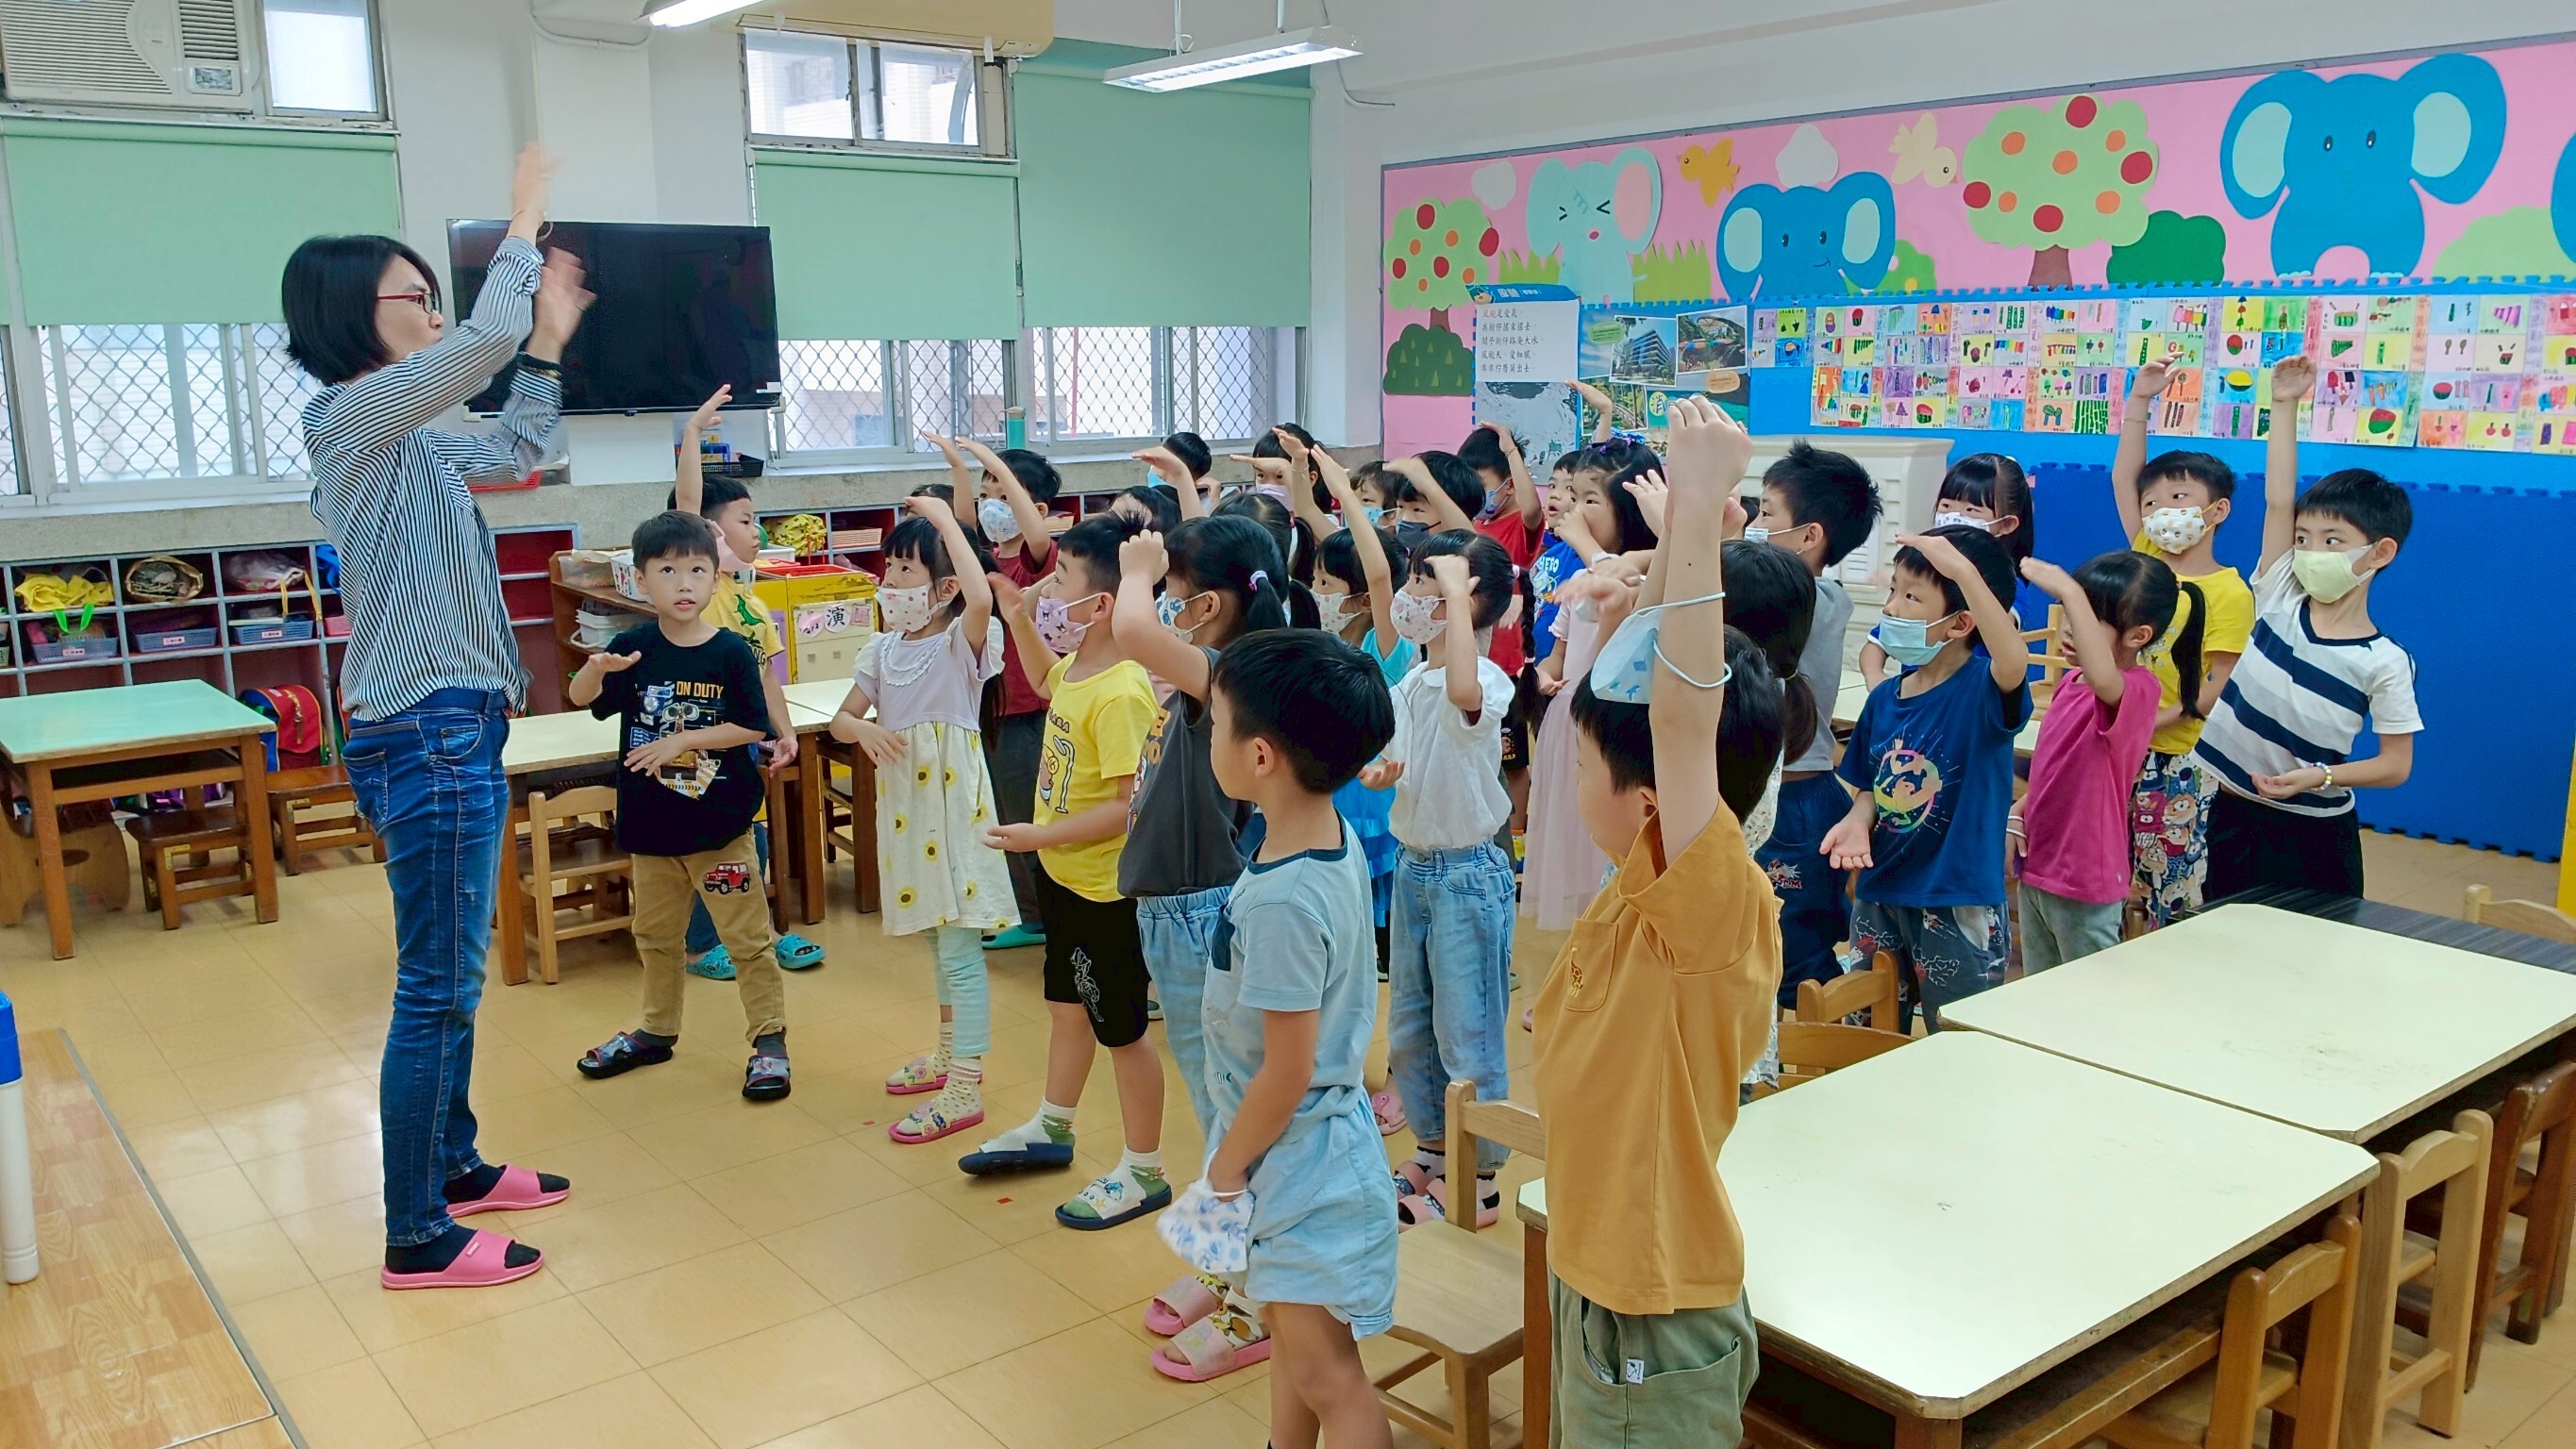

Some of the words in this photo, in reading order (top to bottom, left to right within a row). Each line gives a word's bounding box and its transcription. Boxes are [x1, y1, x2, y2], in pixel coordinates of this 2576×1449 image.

[826, 606, 845, 627] 演
[676, 681, 692, 696] ON
[694, 682, 725, 699] DUTY
